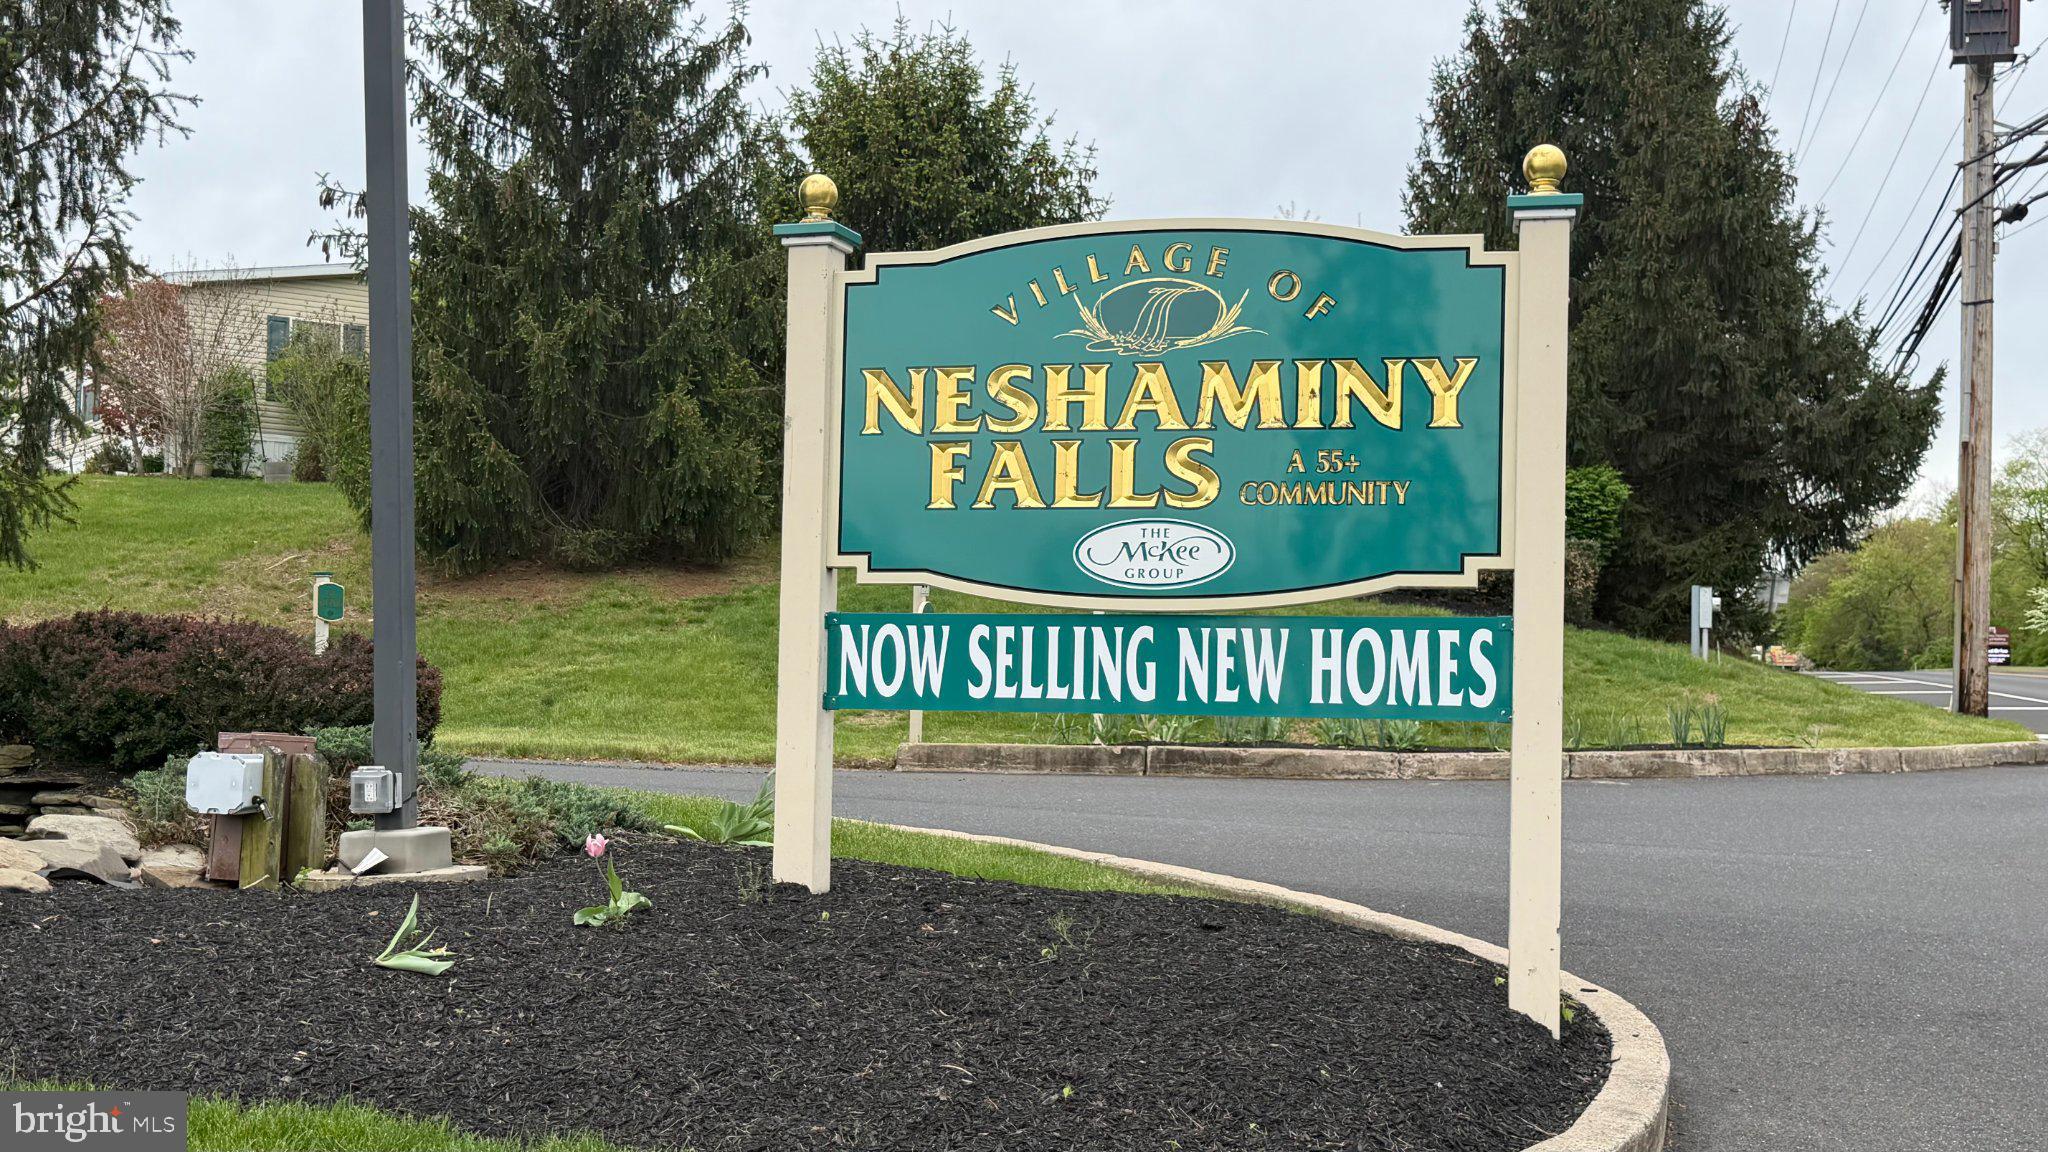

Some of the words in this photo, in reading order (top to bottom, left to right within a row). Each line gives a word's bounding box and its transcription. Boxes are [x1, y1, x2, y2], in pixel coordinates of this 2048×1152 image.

[989, 242, 1229, 326] VILLAGE
[1266, 269, 1338, 321] OF
[860, 356, 1480, 436] NESHAMINY
[925, 436, 1221, 511] FALLS
[1286, 449, 1306, 473] A
[1315, 449, 1361, 473] 55+
[1239, 480, 1412, 506] COMMUNITY
[1140, 528, 1170, 539] THE
[1087, 536, 1221, 566] McKee
[1124, 568, 1184, 579] GROUP
[838, 623, 950, 698] NOW
[967, 624, 1156, 703] SELLING
[1176, 627, 1290, 704] NEW
[1309, 627, 1497, 708] HOMES
